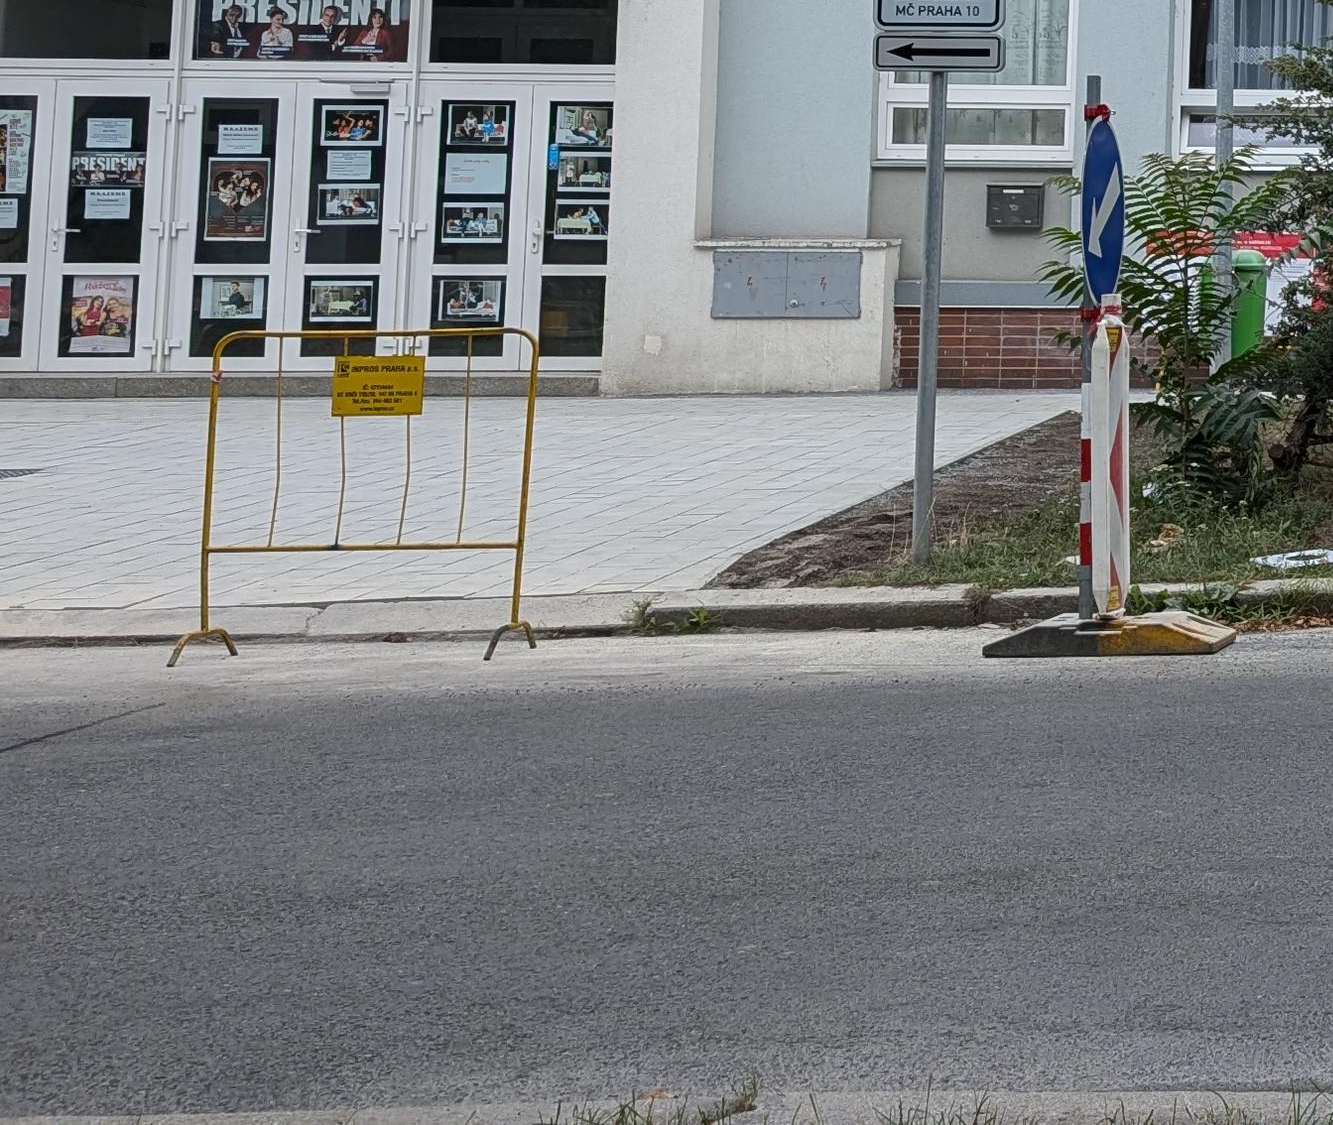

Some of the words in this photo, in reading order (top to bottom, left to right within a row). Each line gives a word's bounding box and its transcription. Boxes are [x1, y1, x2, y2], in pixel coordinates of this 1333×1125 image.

[895, 2, 915, 17] MČ
[918, 4, 962, 17] PRAHA
[965, 4, 980, 17] 10
